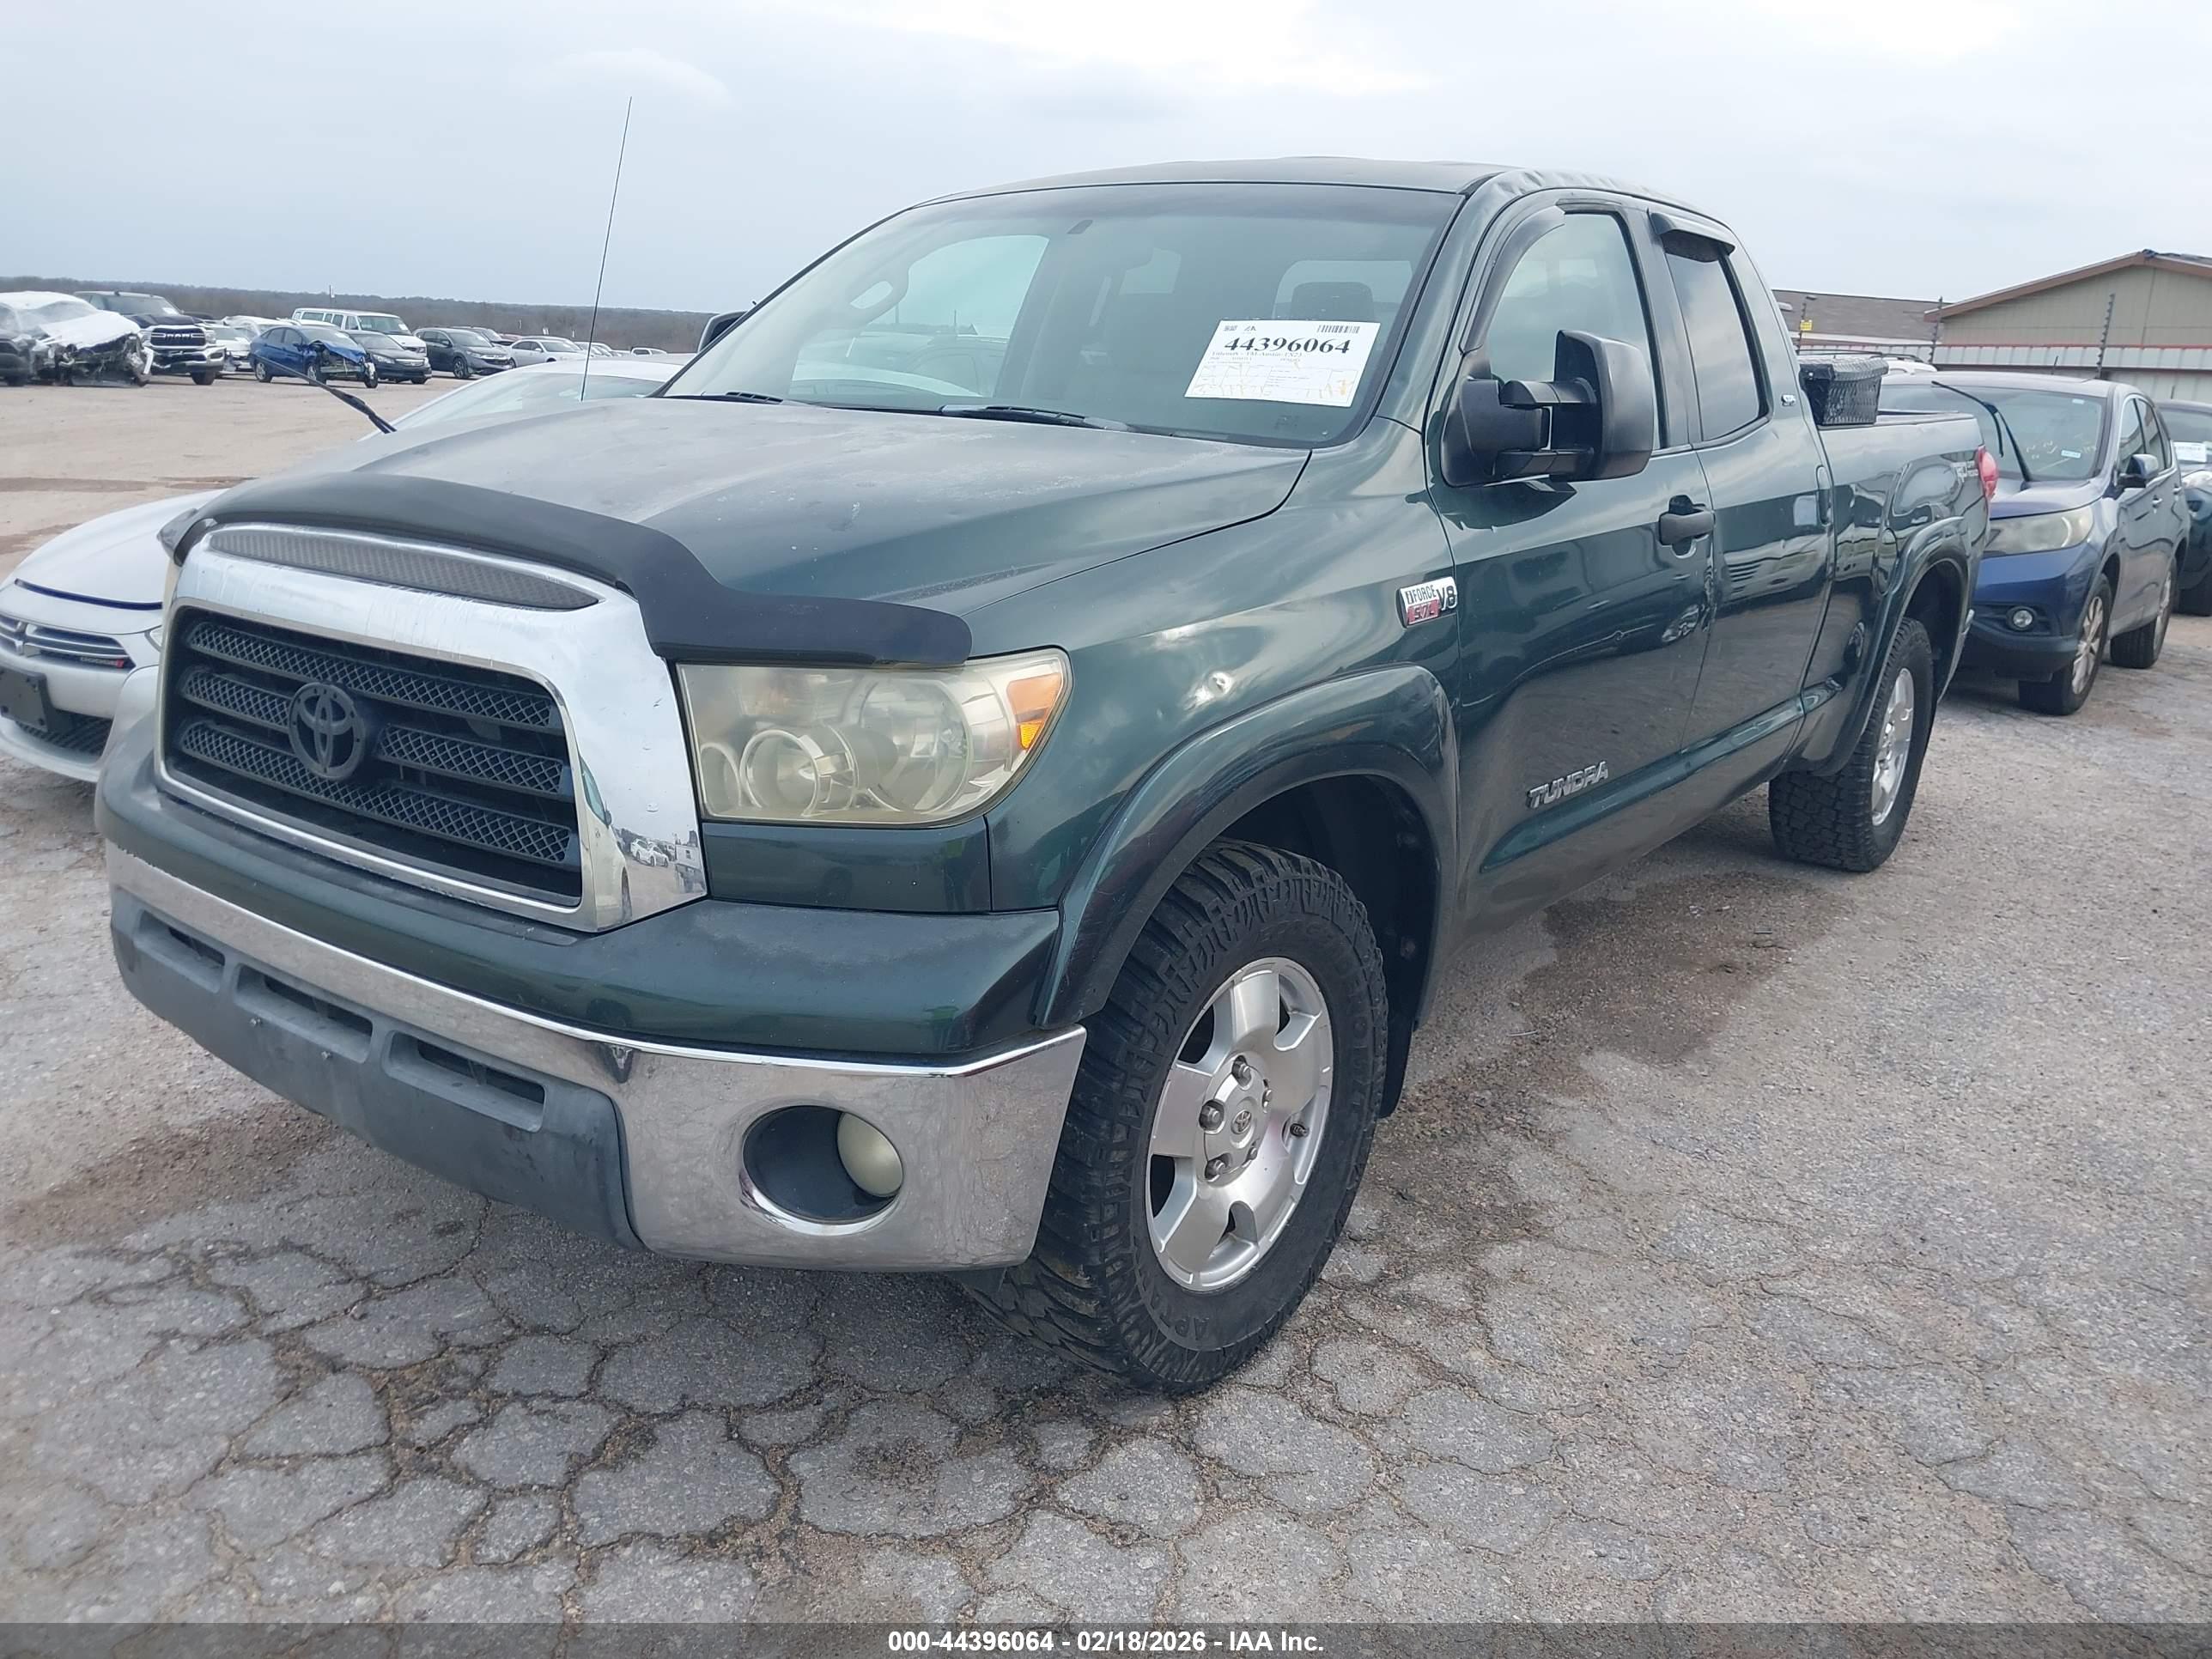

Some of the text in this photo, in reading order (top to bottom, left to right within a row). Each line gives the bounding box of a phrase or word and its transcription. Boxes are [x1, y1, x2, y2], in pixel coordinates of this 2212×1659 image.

[1224, 337, 1352, 354] 44396064
[1436, 585, 1457, 611] V8
[1527, 761, 1608, 808] TUNDRA
